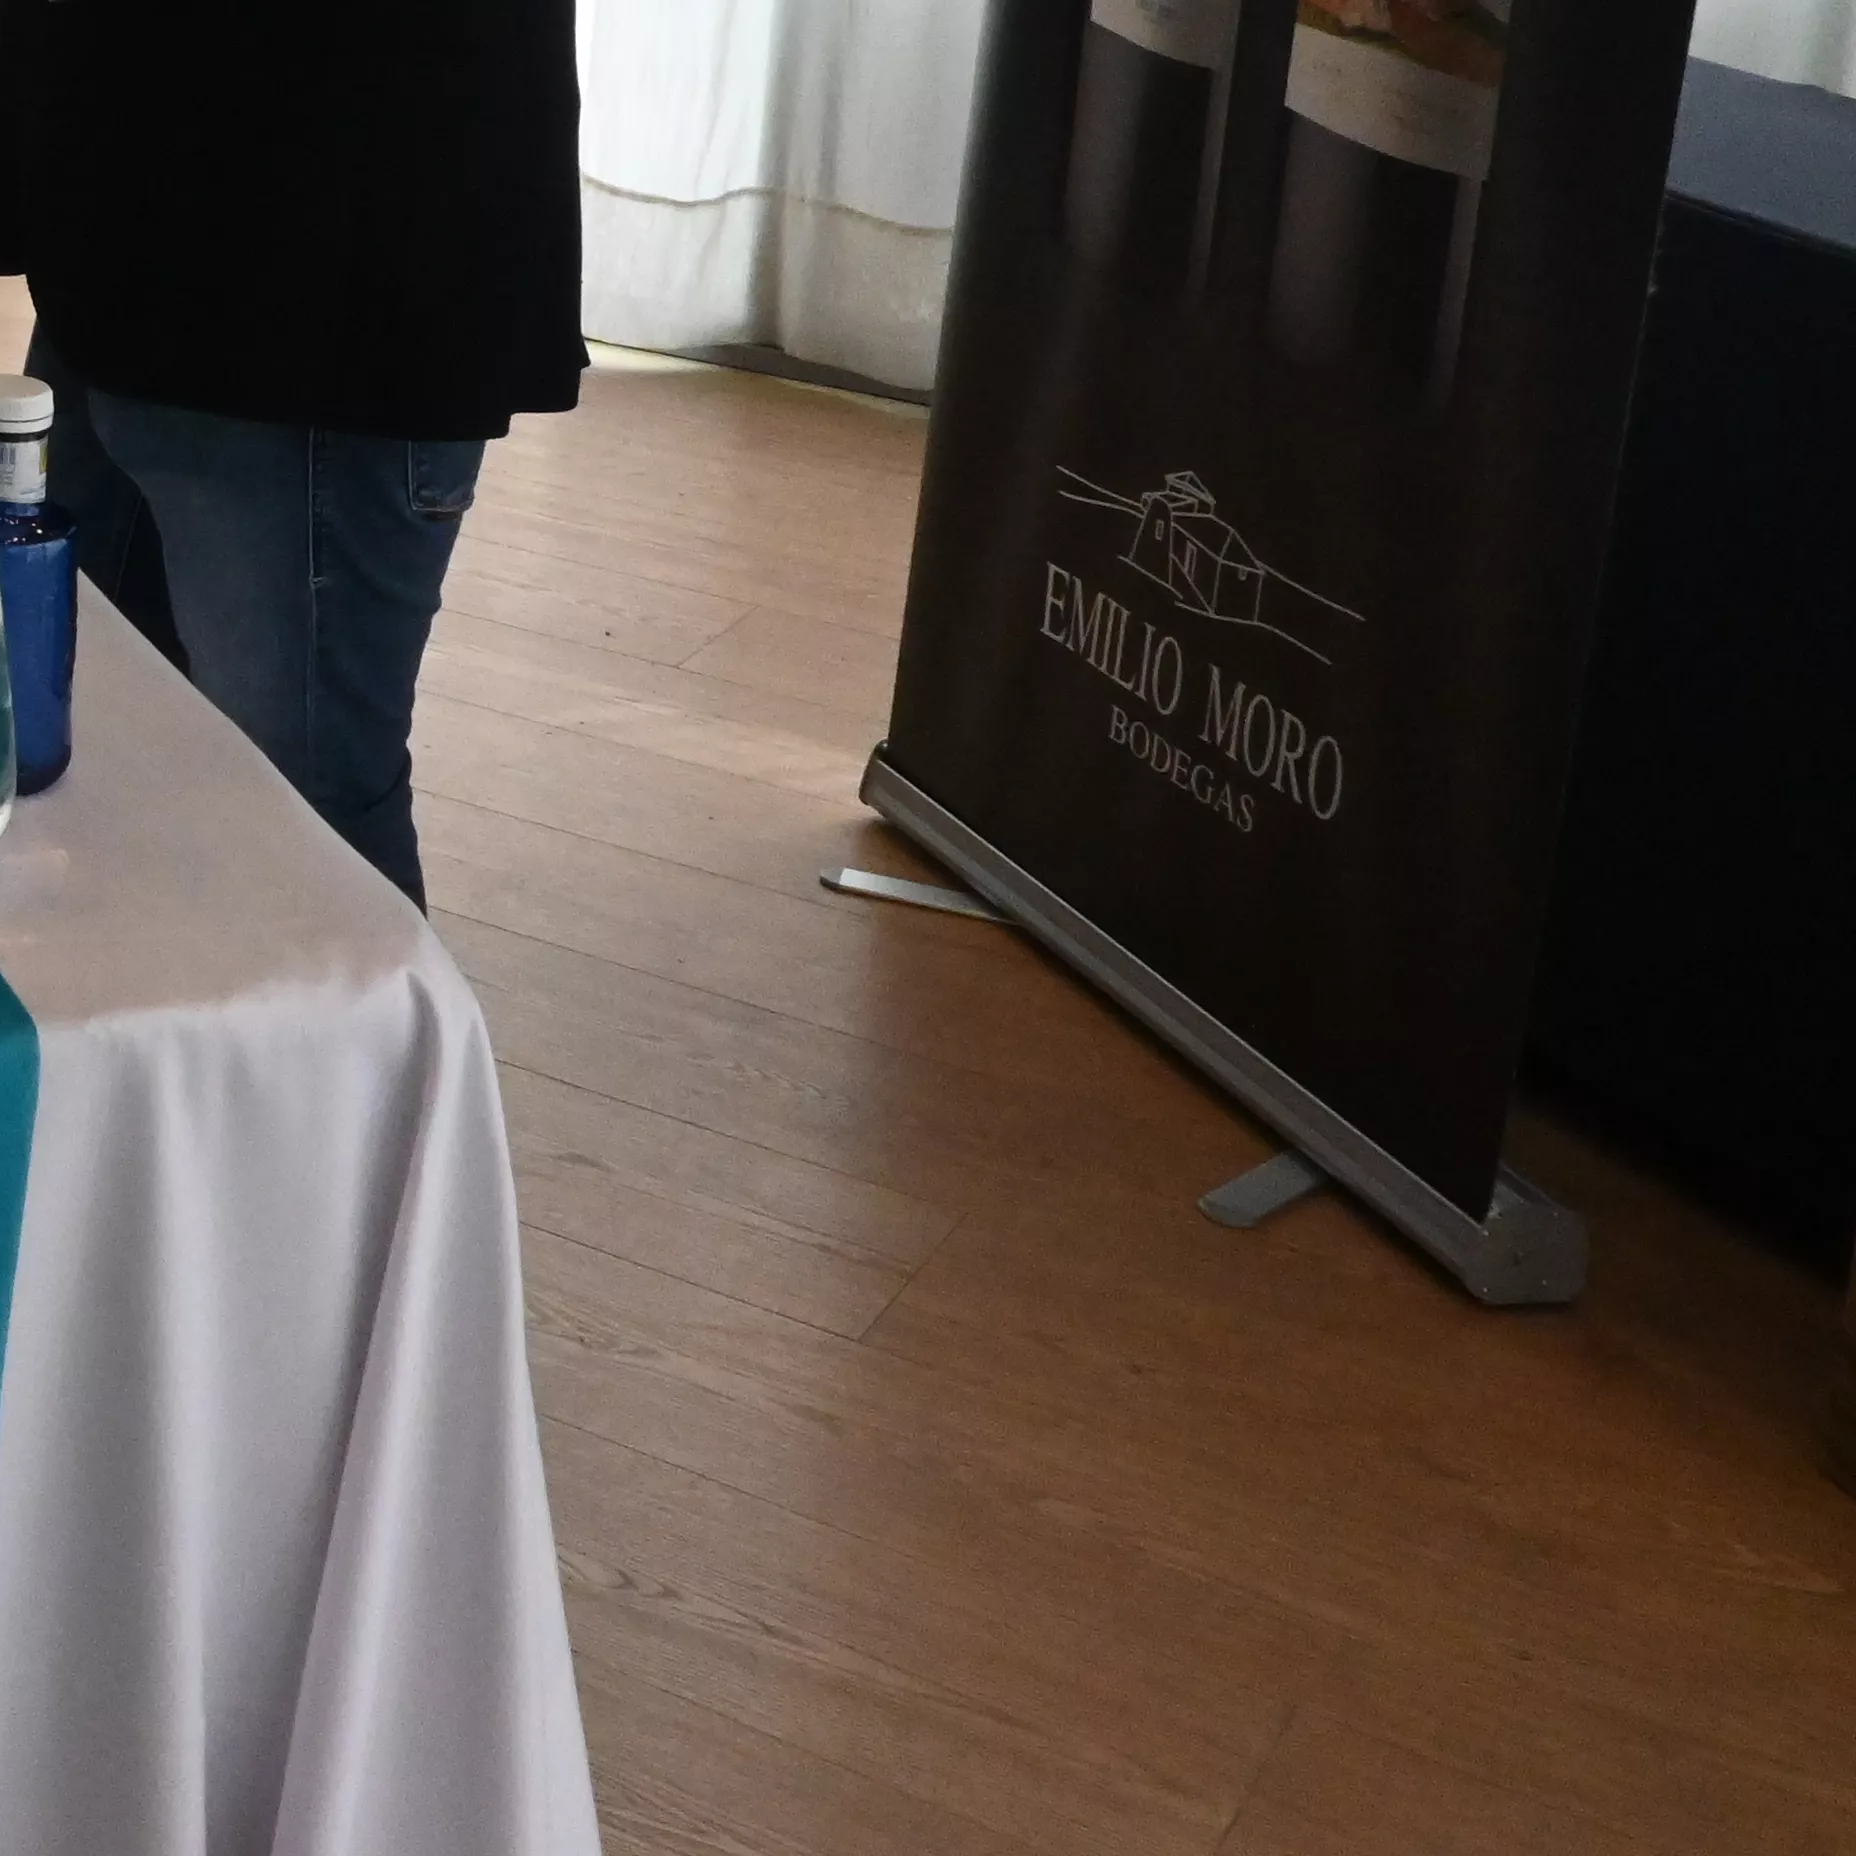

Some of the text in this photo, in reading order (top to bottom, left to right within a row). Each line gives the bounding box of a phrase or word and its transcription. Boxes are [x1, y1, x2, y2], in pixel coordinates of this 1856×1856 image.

[1040, 561, 1344, 821] EMILIO MORO
[1108, 705, 1255, 833] BODEGAS
